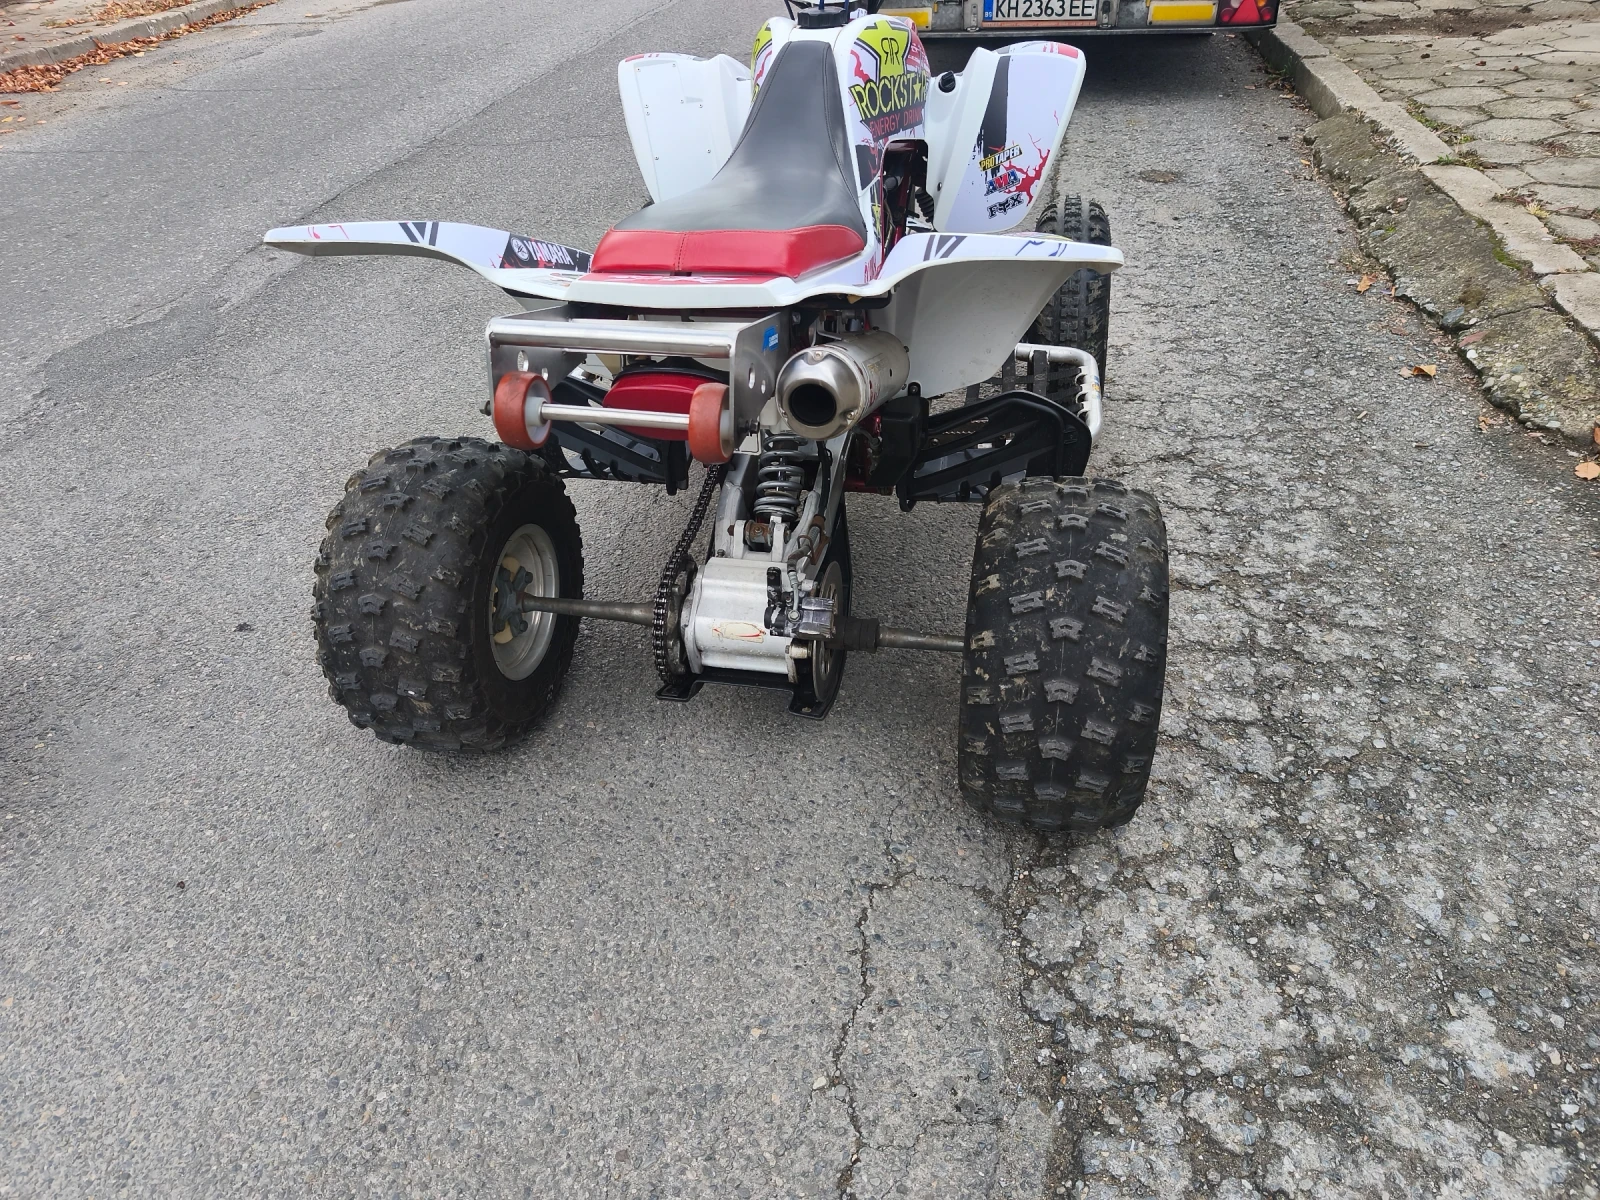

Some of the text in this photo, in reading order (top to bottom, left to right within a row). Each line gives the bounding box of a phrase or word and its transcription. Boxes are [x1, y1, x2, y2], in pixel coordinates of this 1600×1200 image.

[995, 0, 1093, 18] KH 2363 EE
[869, 112, 900, 139] ENERGY
[523, 239, 575, 266] YAMAHA
